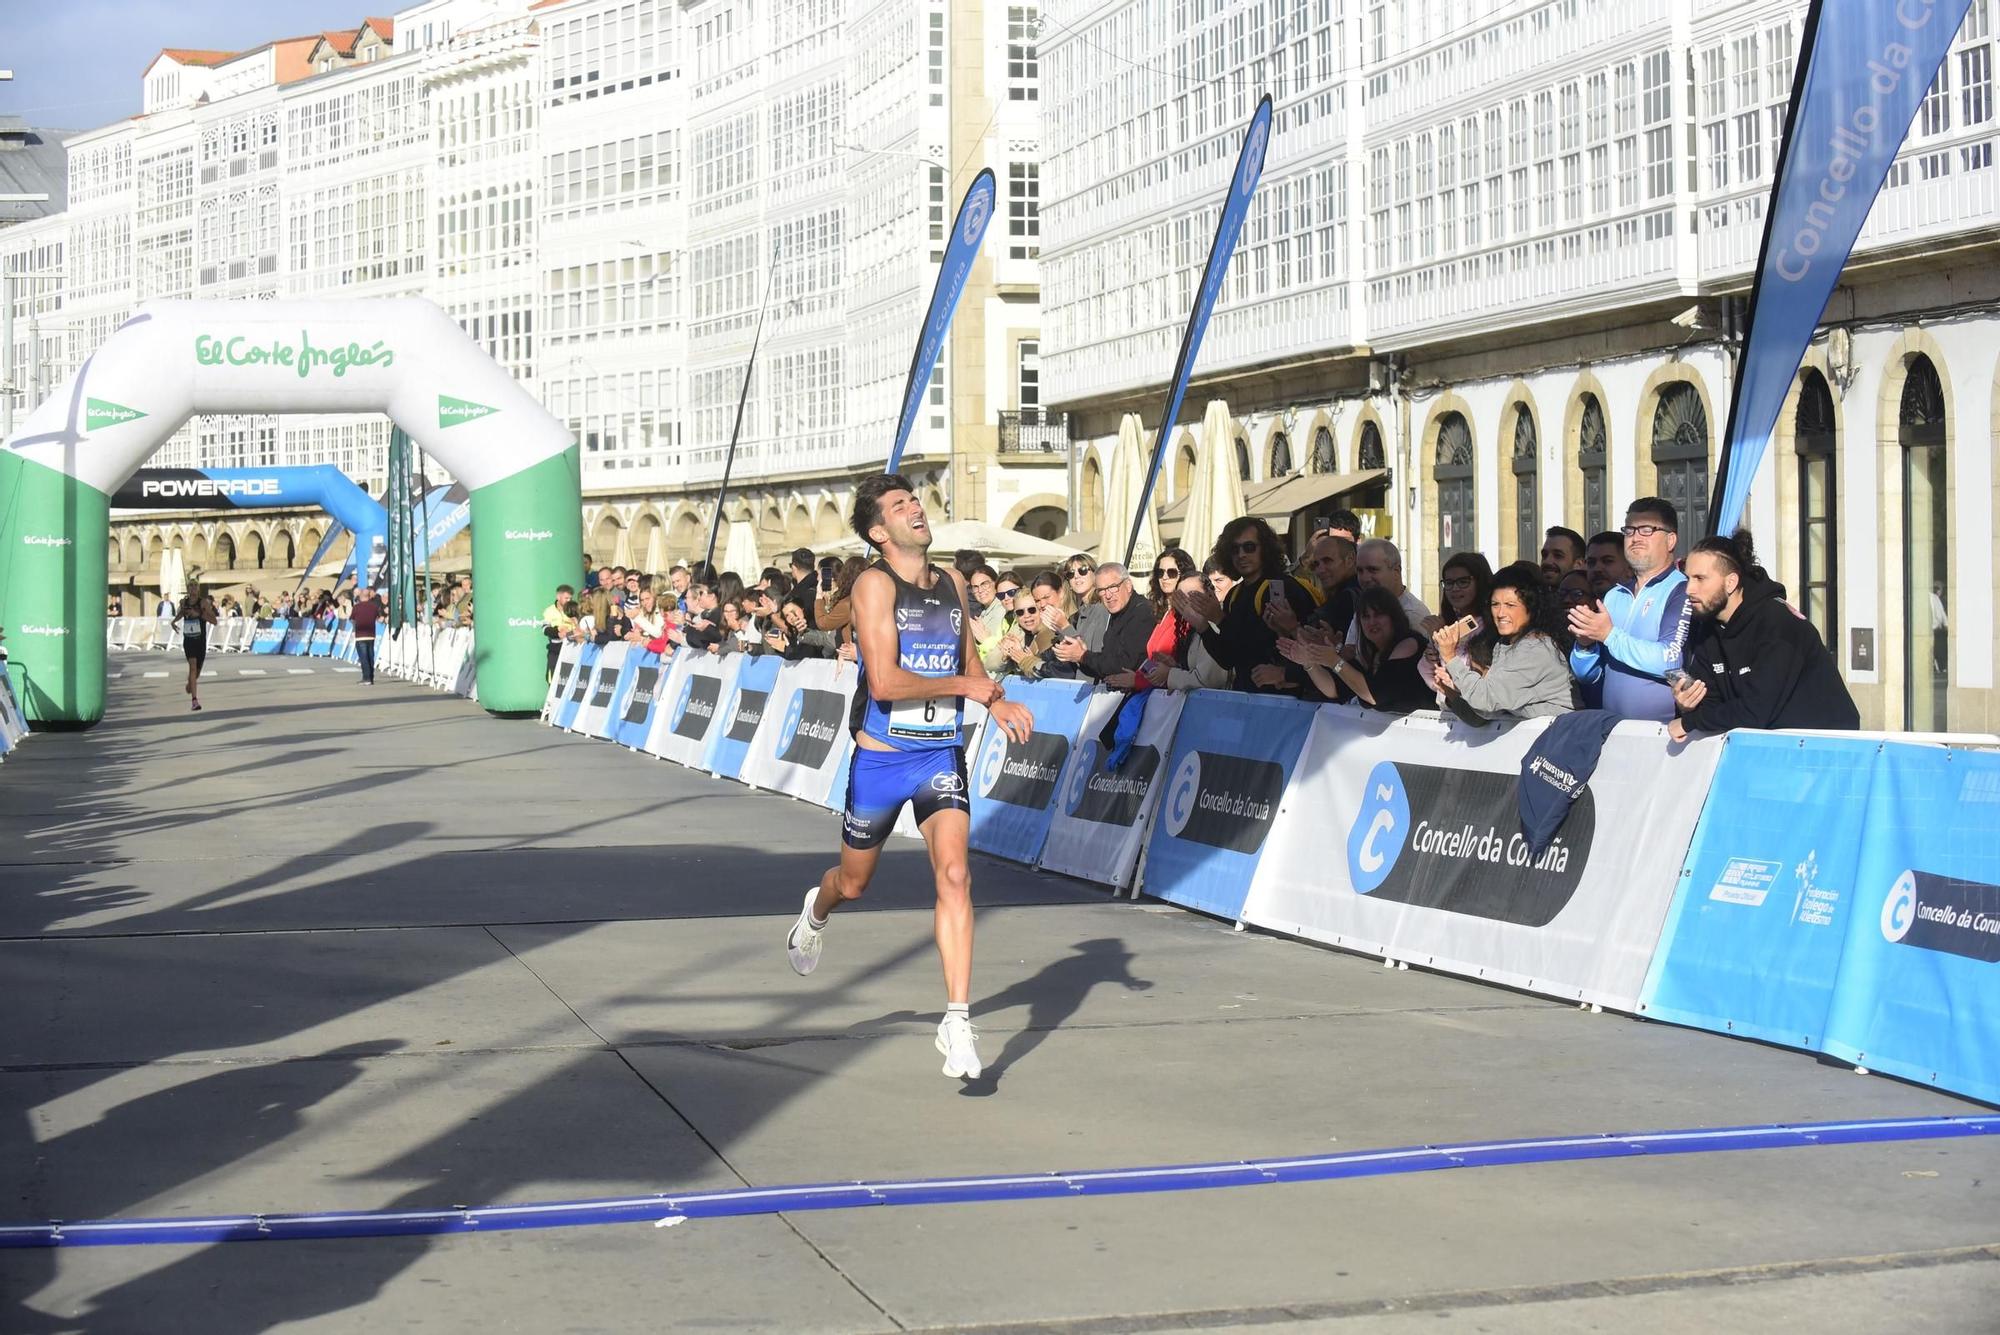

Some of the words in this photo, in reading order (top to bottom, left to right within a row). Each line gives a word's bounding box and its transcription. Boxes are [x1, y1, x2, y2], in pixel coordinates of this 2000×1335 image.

[1776, 106, 1879, 282] Concello
[1867, 42, 1912, 94] da
[924, 336, 937, 362] da
[935, 261, 967, 332] Coruña
[195, 334, 224, 366] El
[226, 335, 294, 366] Corte
[297, 328, 394, 378] Inglés
[142, 479, 280, 497] POWERADE
[912, 642, 927, 650] CLUB
[924, 699, 936, 723] 6
[1004, 756, 1030, 777] Concello
[1200, 788, 1232, 813] Concello
[1231, 794, 1243, 815] da
[1412, 820, 1479, 859] Concello
[1477, 826, 1503, 863] da
[1917, 901, 1957, 925] Concello
[1956, 909, 1973, 928] da
